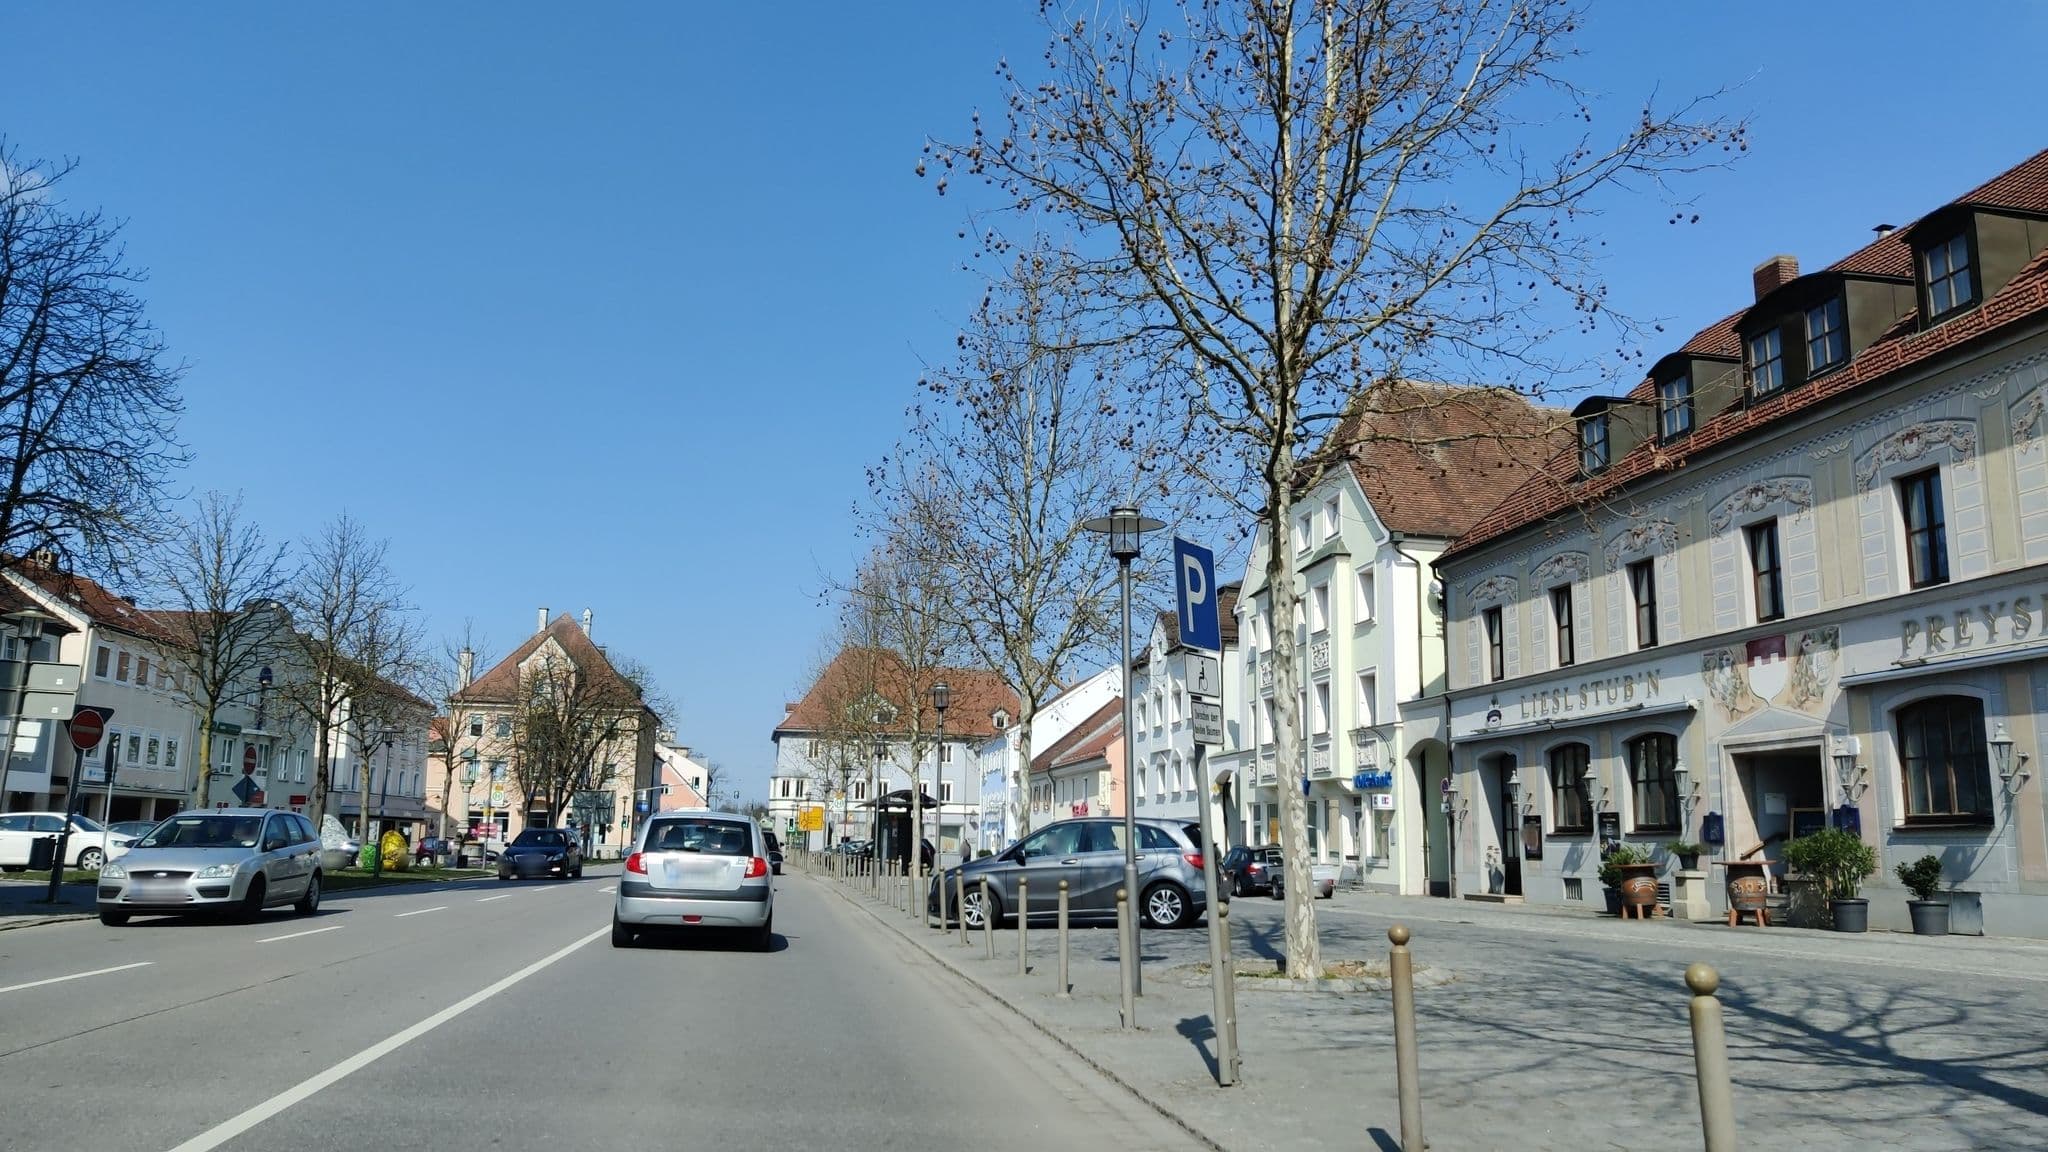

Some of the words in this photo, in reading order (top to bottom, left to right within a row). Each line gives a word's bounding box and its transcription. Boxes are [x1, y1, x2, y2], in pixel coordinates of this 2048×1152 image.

[1182, 553, 1207, 632] P
[1520, 686, 1574, 719] LIESL
[1579, 668, 1662, 711] STUB'N
